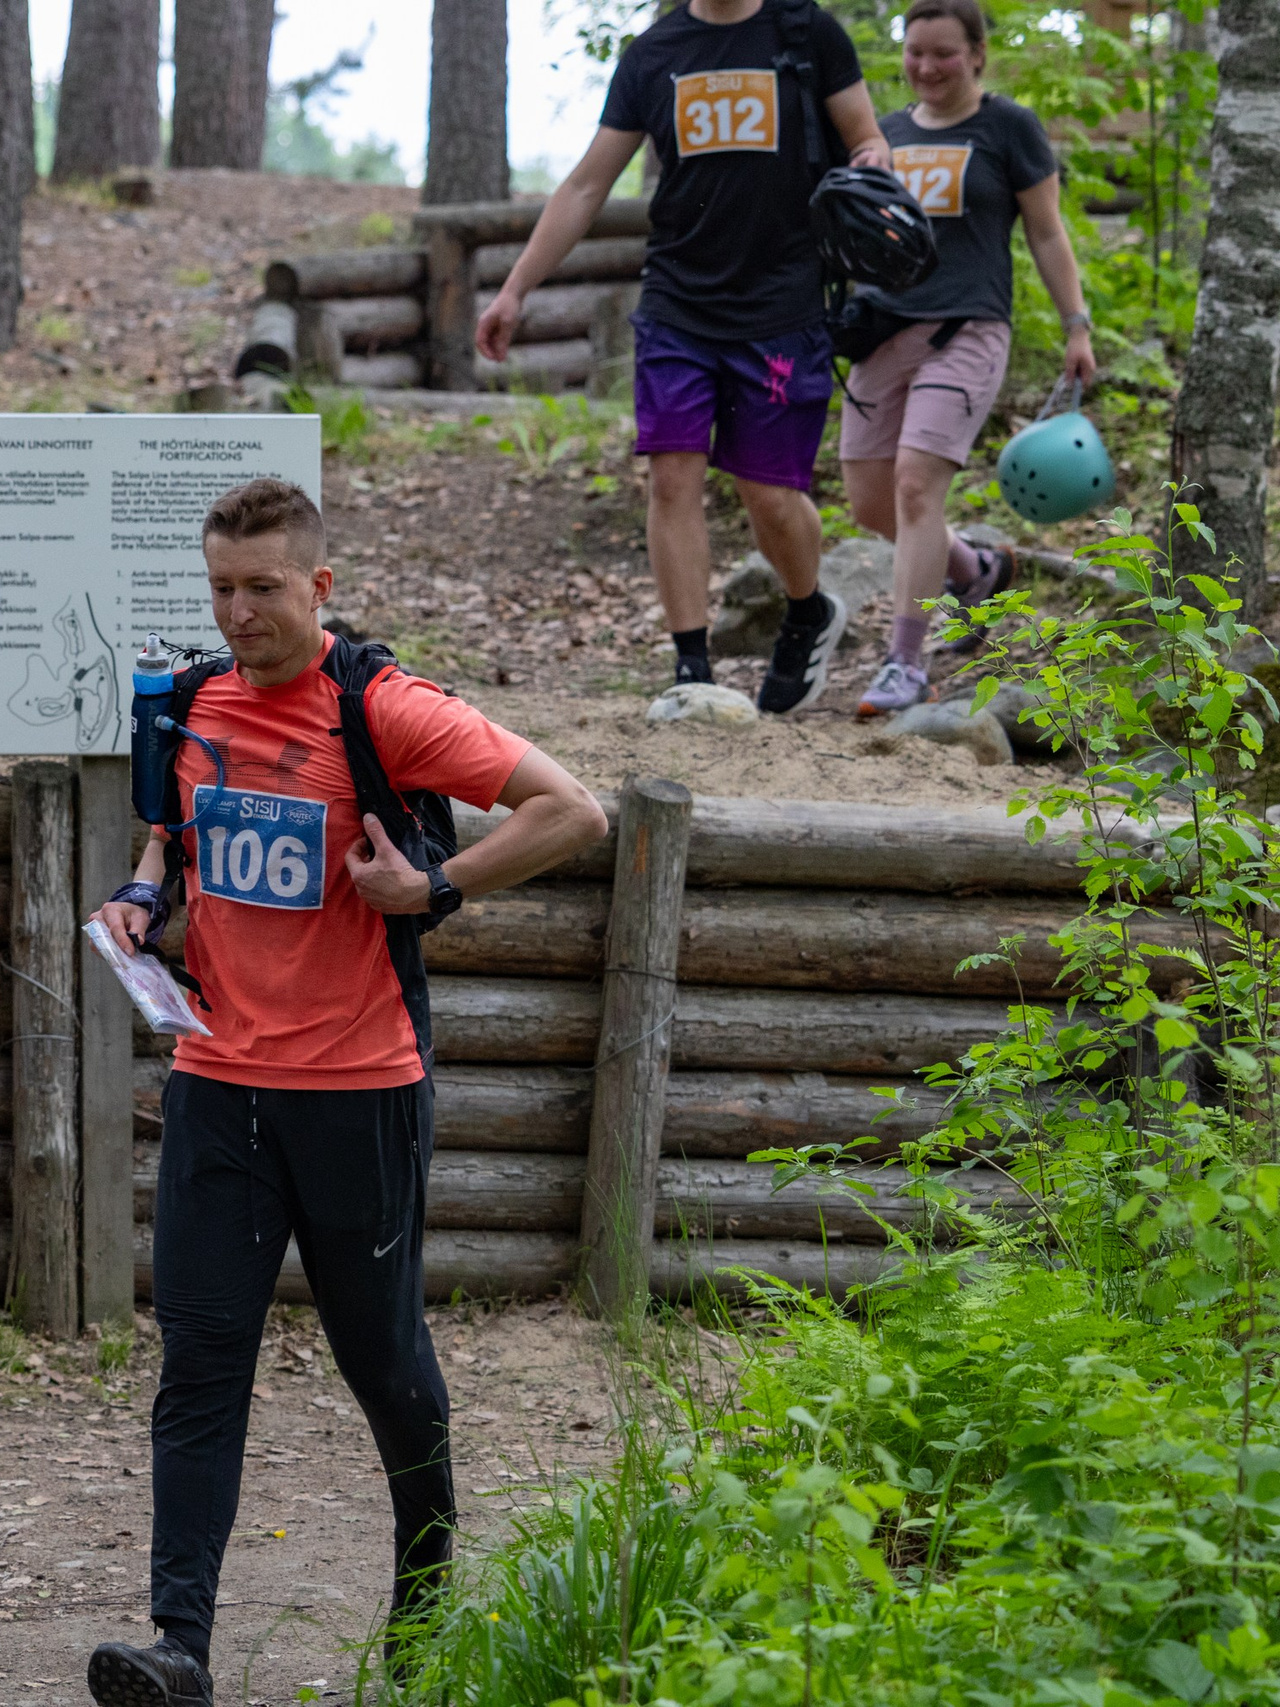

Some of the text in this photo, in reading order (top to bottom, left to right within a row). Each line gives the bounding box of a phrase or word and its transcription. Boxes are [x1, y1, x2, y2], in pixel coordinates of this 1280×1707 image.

[685, 96, 766, 146] 312
[28, 440, 93, 450] LINNOITTEET
[139, 439, 263, 450] THE HÖYTIÄINEN CANAL
[159, 452, 242, 462] FORTIFICATIONS
[240, 796, 281, 822] SISU
[289, 811, 313, 820] PUUTEC
[206, 825, 308, 898] 106
